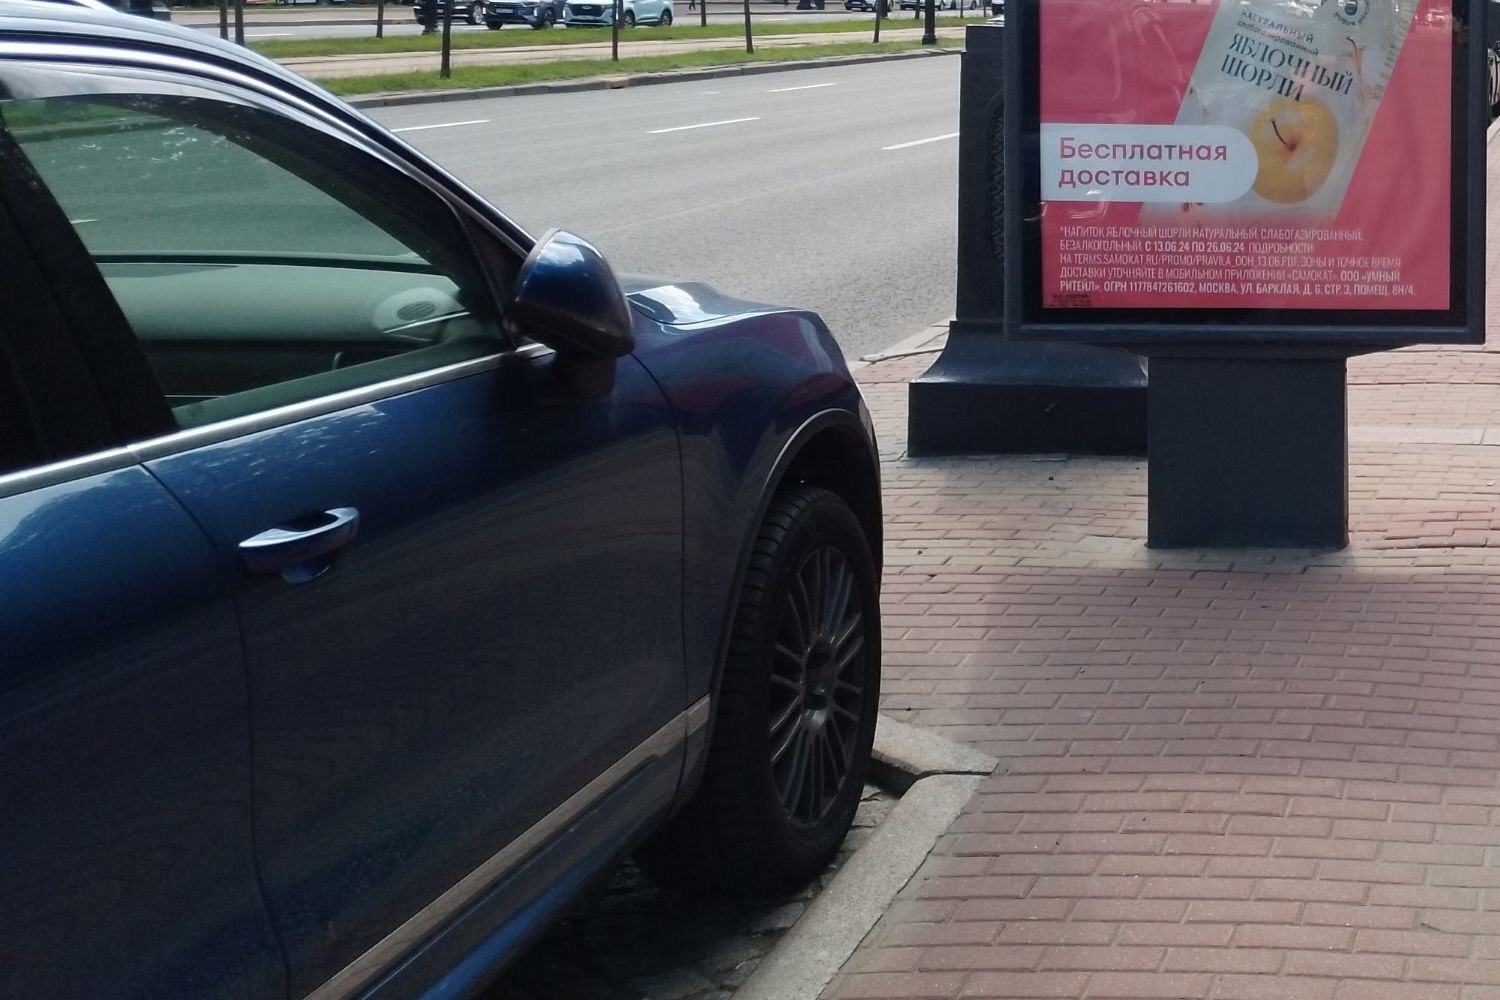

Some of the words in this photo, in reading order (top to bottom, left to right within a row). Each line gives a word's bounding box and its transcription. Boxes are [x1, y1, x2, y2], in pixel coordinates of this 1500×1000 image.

[1240, 9, 1314, 44] НАТУРАЛЬНЫЙ
[1228, 33, 1354, 95] ЯБЛОЧНЫЙ
[1220, 54, 1305, 102] ШОРЛИ
[1060, 136, 1227, 161] Бесплатная
[1058, 168, 1190, 188] доставка
[1106, 226, 1156, 238] ЯБЛОЧНЫЙ
[1159, 227, 1190, 238] ШОРЛИ
[1145, 241, 1151, 251] С
[1154, 241, 1189, 251] 13.06.24
[1192, 242, 1205, 252] ПО
[1249, 243, 1313, 254] ПОДРОБНОСТИ
[1060, 254, 1072, 264] НА
[1301, 256, 1326, 267] ЗОНЫ
[1328, 257, 1335, 267] И
[1337, 257, 1369, 268] ТОЧНОЕ
[1372, 257, 1401, 268] ВРЕМЯ
[1060, 267, 1106, 279] ДОСТАВКИ
[1107, 267, 1155, 279] УТОЧНЯЙТЕ
[1158, 269, 1164, 278] В
[1166, 268, 1222, 279] МОБИЛЬНОМ
[1225, 269, 1285, 280] ПРИЛОЖЕНИИ
[1340, 270, 1359, 281] ООО
[1362, 269, 1400, 282] «УМНЫЙ
[1104, 281, 1126, 291] ОГРН
[1199, 283, 1239, 294] МОСКВА,
